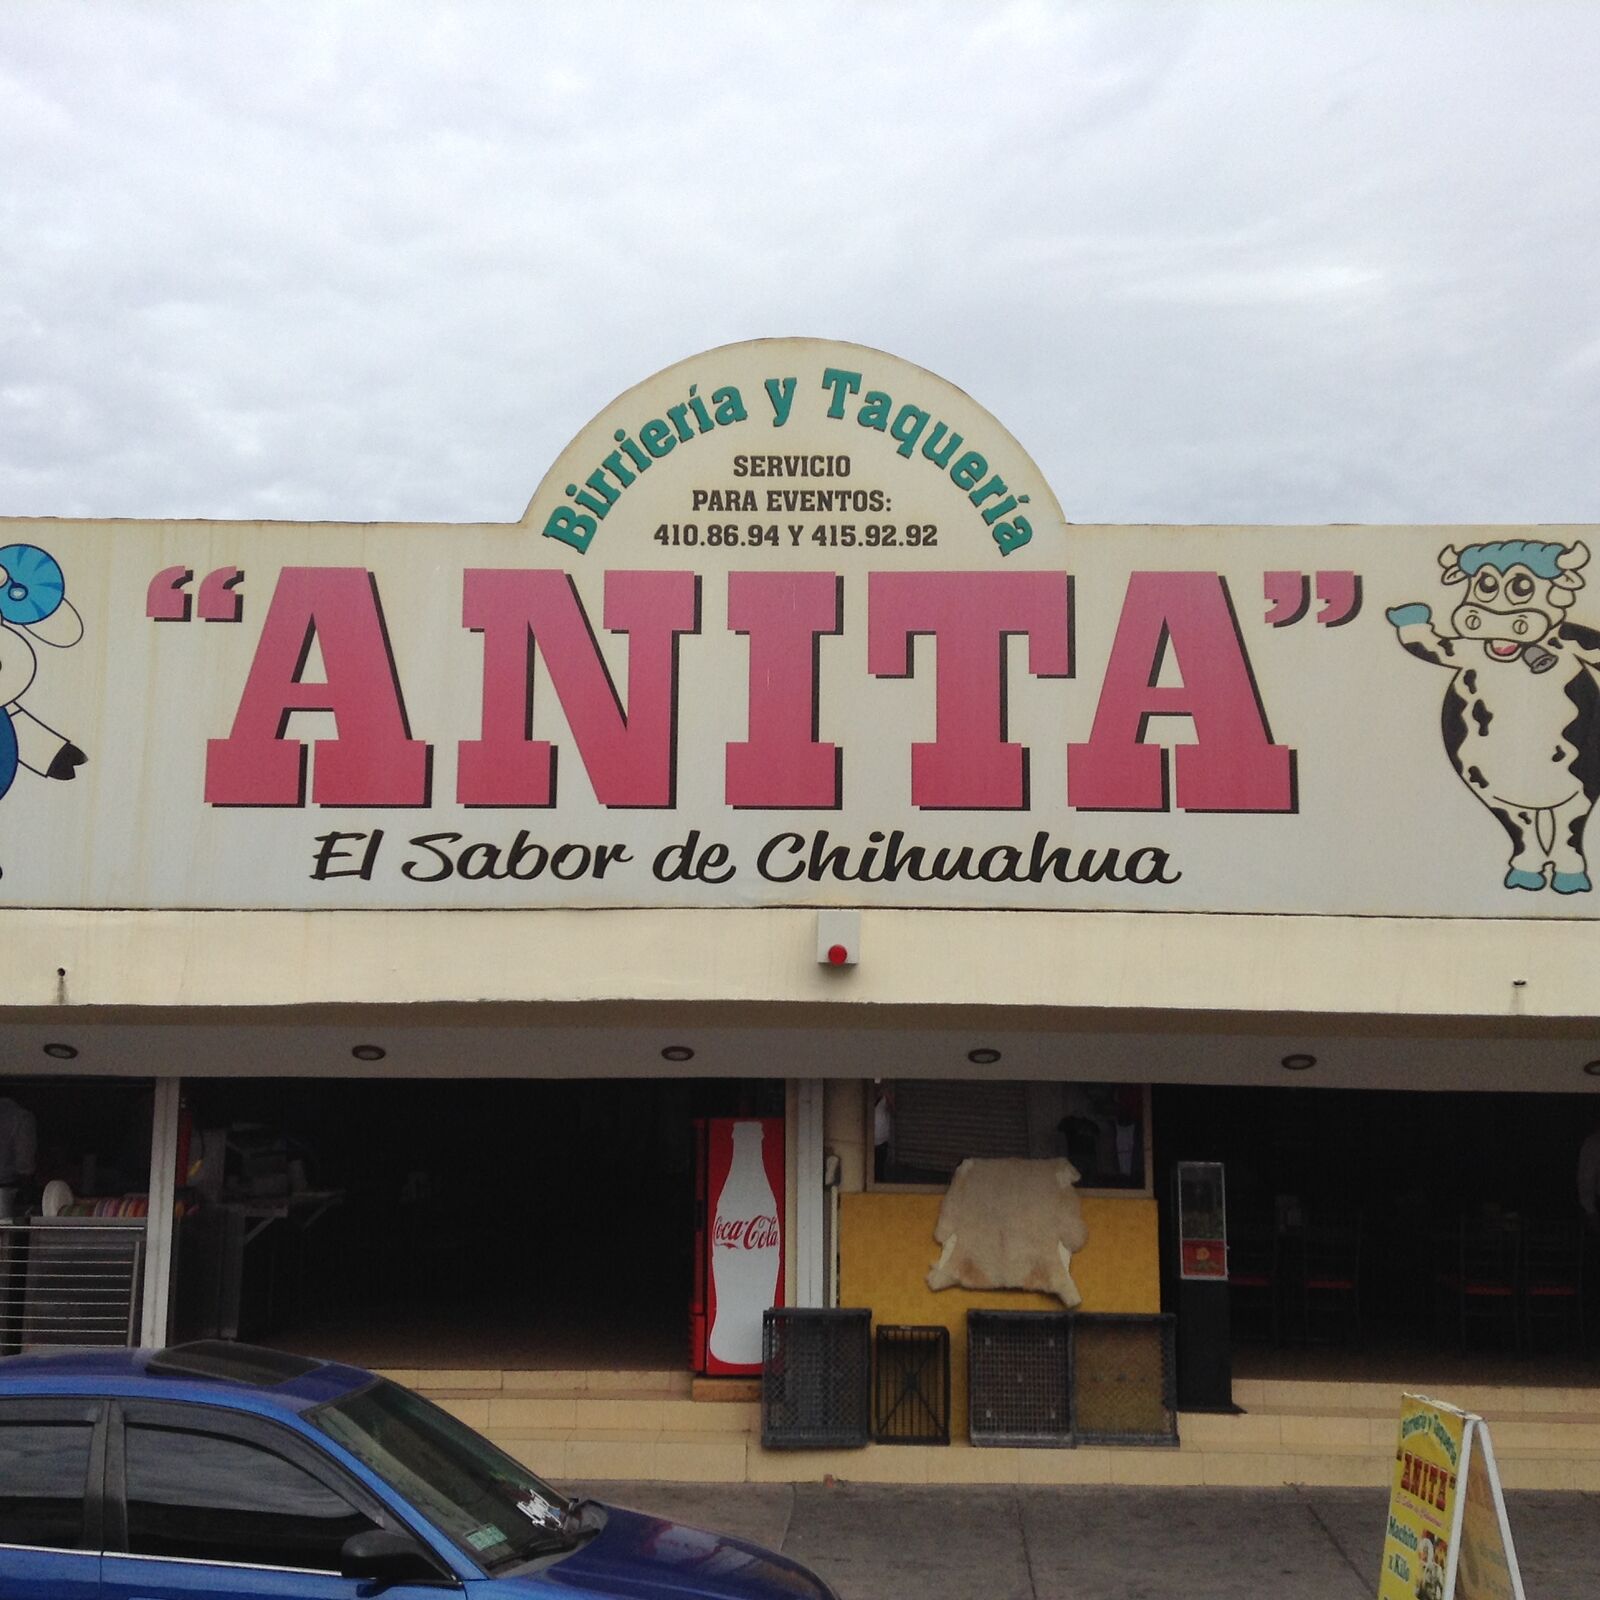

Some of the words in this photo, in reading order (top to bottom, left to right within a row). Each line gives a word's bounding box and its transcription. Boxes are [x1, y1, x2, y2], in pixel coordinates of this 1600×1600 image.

[542, 383, 748, 555] Birriería
[764, 377, 797, 427] y
[821, 367, 1034, 557] Taquería
[733, 455, 851, 477] SERVICIO
[692, 490, 759, 511] PARA
[766, 490, 891, 512] EVENTOS:
[653, 524, 780, 547] 410.86.94
[788, 525, 804, 547] Y
[811, 524, 938, 547] 415.92.92
[309, 829, 385, 881] El
[401, 829, 634, 883] Sabor
[652, 829, 737, 884] de
[756, 829, 1183, 884] Chihuahua
